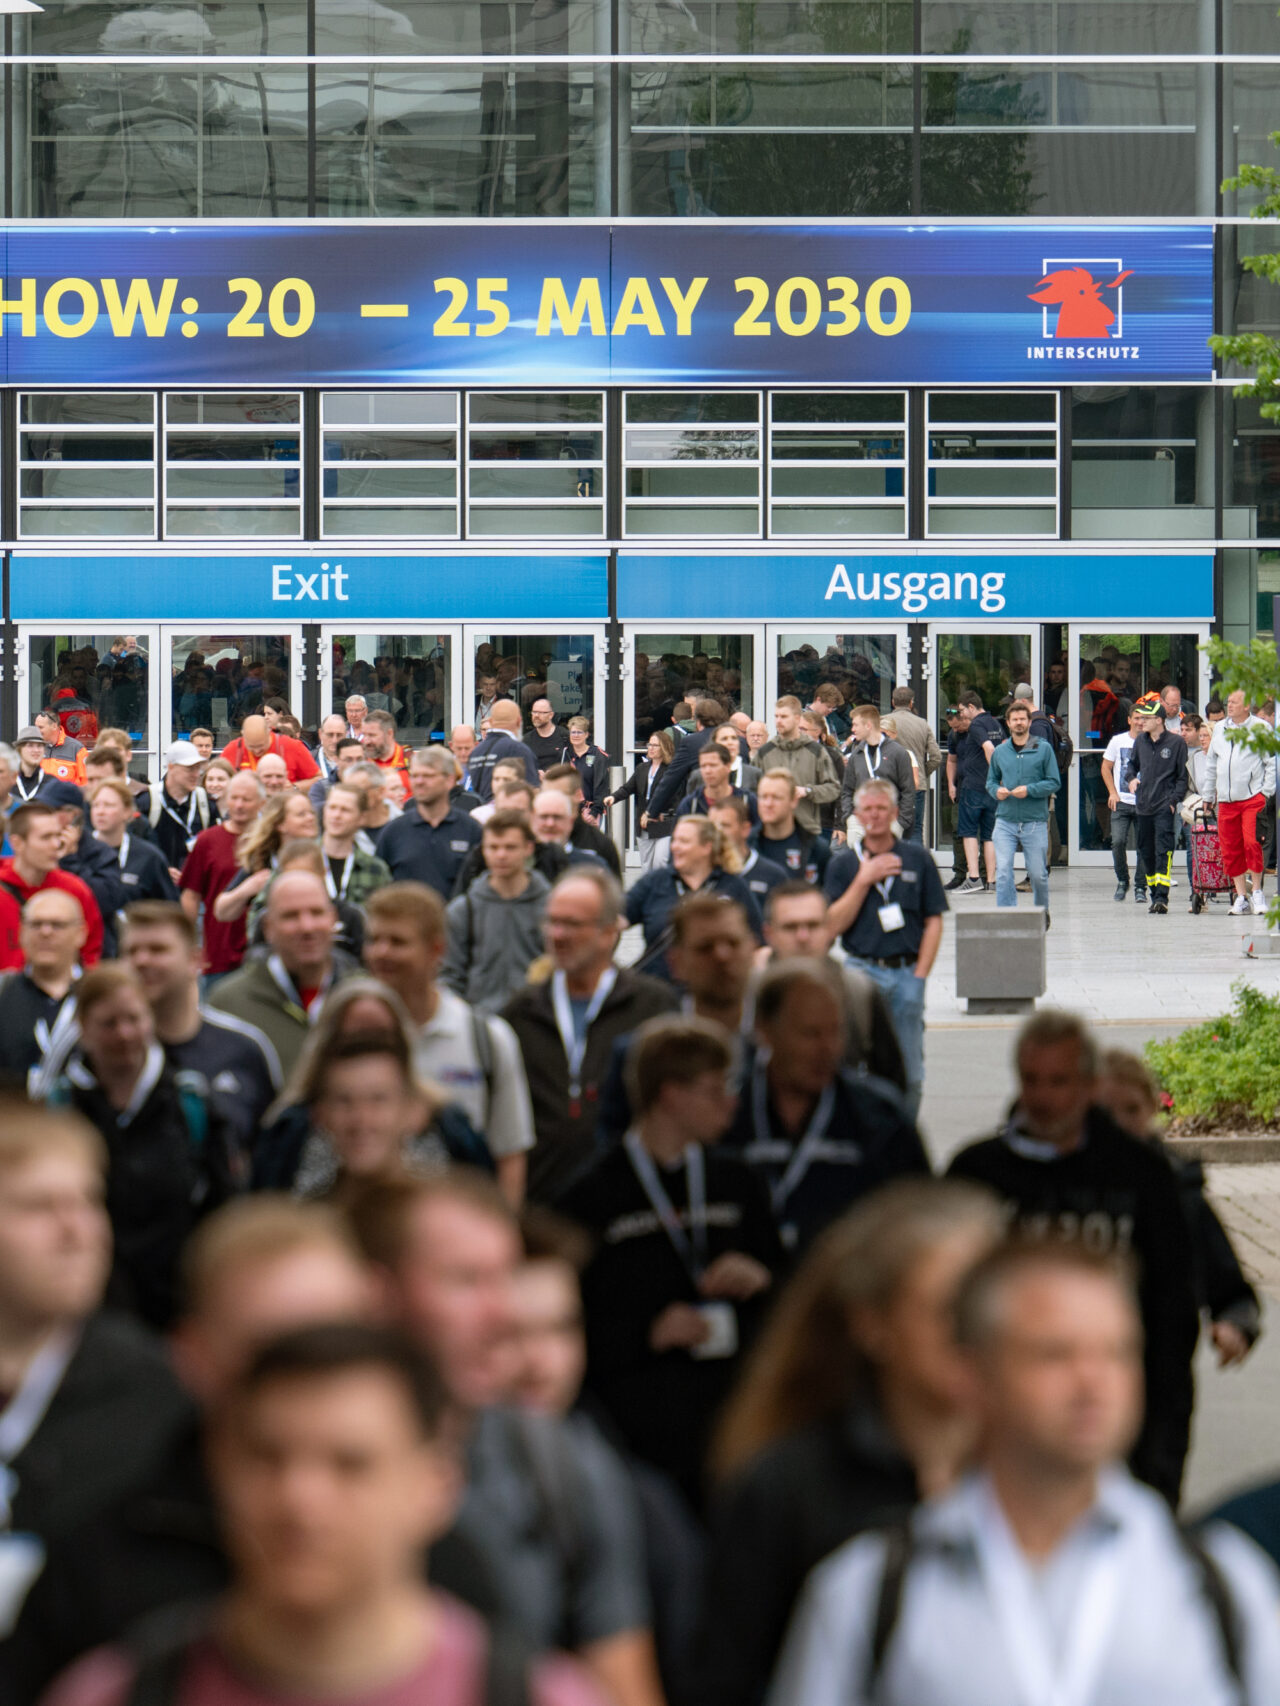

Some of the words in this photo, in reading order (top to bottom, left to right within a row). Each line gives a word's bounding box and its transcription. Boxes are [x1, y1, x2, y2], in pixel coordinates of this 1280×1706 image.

[227, 277, 316, 338] 20
[433, 277, 510, 337] 25
[536, 277, 709, 336] MAY
[733, 276, 912, 337] 2030
[1027, 346, 1140, 359] INTERSCHUTZ
[272, 562, 349, 601] Exit
[824, 563, 1006, 613] Ausgang
